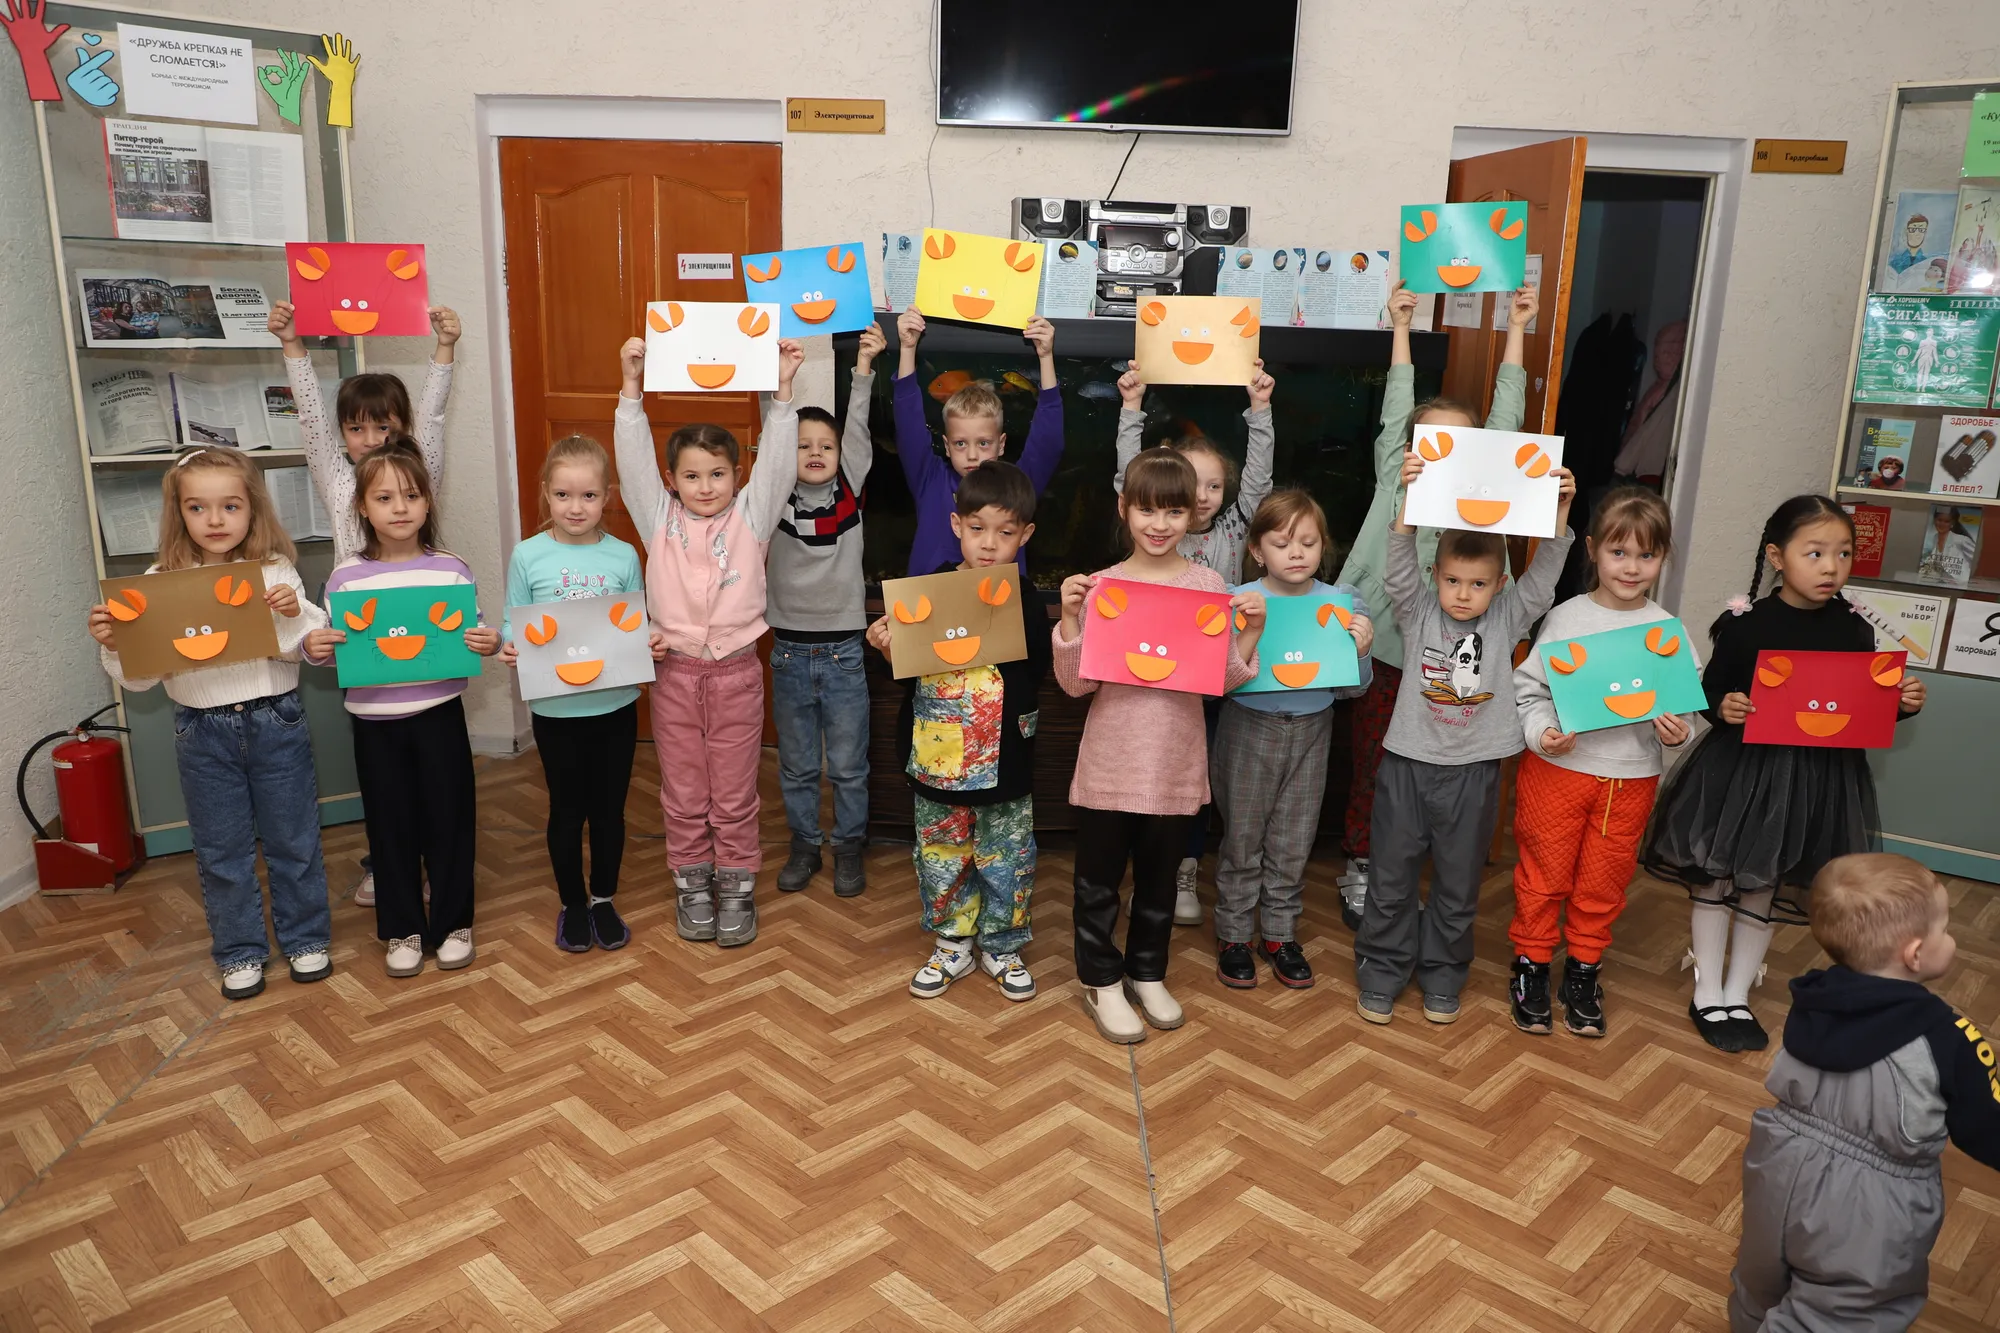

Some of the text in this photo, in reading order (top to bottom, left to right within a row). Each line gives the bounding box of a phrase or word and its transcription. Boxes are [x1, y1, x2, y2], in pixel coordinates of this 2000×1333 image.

[129, 37, 243, 57] «ДРУЖБА КРЕПКАЯ НЕ
[150, 53, 227, 69] СЛОМАЕТСЯ!»
[171, 81, 212, 90] ТЕРРОРИЗМОМ
[790, 109, 875, 121] 107 Электрощитовая
[113, 133, 164, 145] Питер-герой
[1756, 151, 1829, 163] 108 Гардеробная
[1886, 308, 1960, 321] СИГАРЕТЫ
[1950, 417, 1994, 426] ЗДОРОВЬЕ
[1949, 484, 1976, 493] ПЕПЕЛ
[562, 573, 606, 588] ENJOY
[1915, 603, 1936, 612] ТВОЙ
[1954, 645, 1997, 656] здоровый
